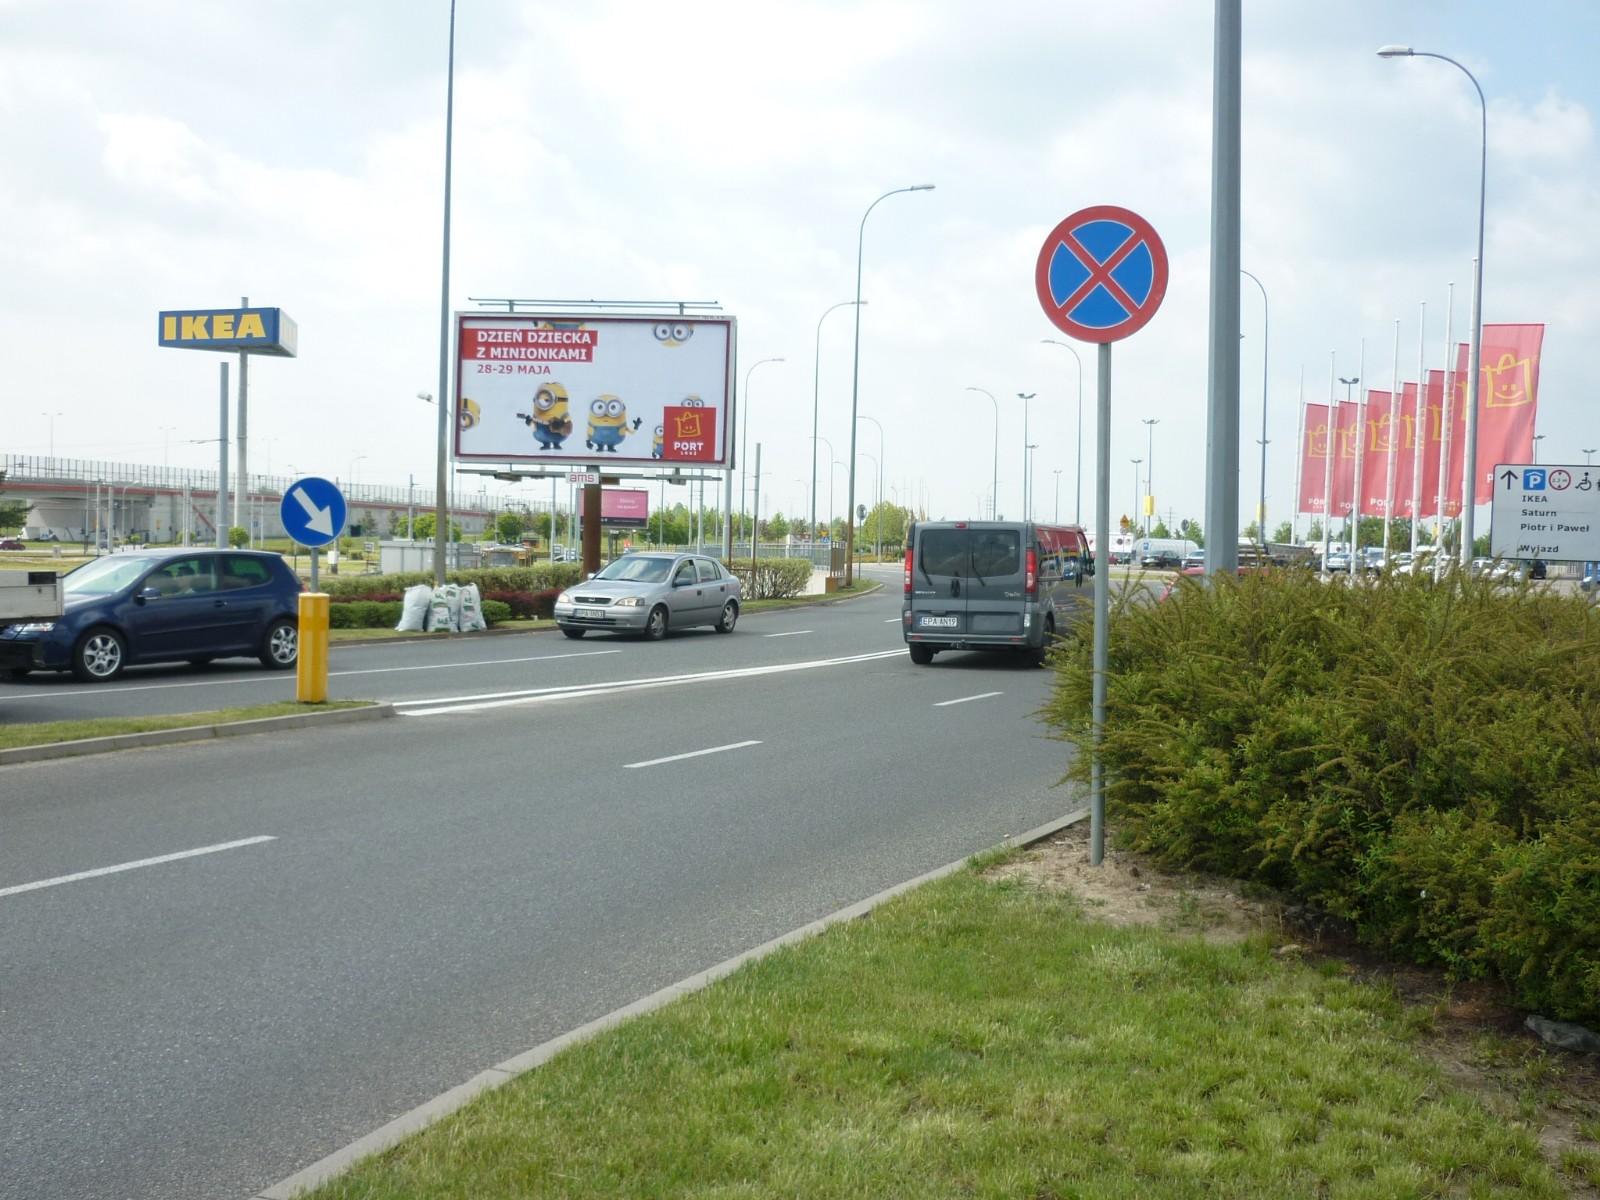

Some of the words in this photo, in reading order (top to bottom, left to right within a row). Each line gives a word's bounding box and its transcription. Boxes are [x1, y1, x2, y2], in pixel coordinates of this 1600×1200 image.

[164, 313, 266, 341] IKEA
[477, 328, 523, 343] DZIEŃ
[528, 332, 591, 344] DZIECKA
[476, 347, 486, 358] Z
[490, 347, 588, 360] MINIONKAMI
[477, 364, 513, 374] 28-29
[518, 365, 551, 375] MAJA
[674, 441, 704, 452] PORT
[569, 474, 595, 482] ams
[1521, 495, 1548, 503] IKEA
[1521, 509, 1557, 517] Saturn
[1520, 523, 1546, 531] Piotr
[1550, 523, 1553, 531] i
[1519, 544, 1559, 554] Wyjazd
[923, 617, 937, 625] EPA
[940, 617, 956, 625] AN19
